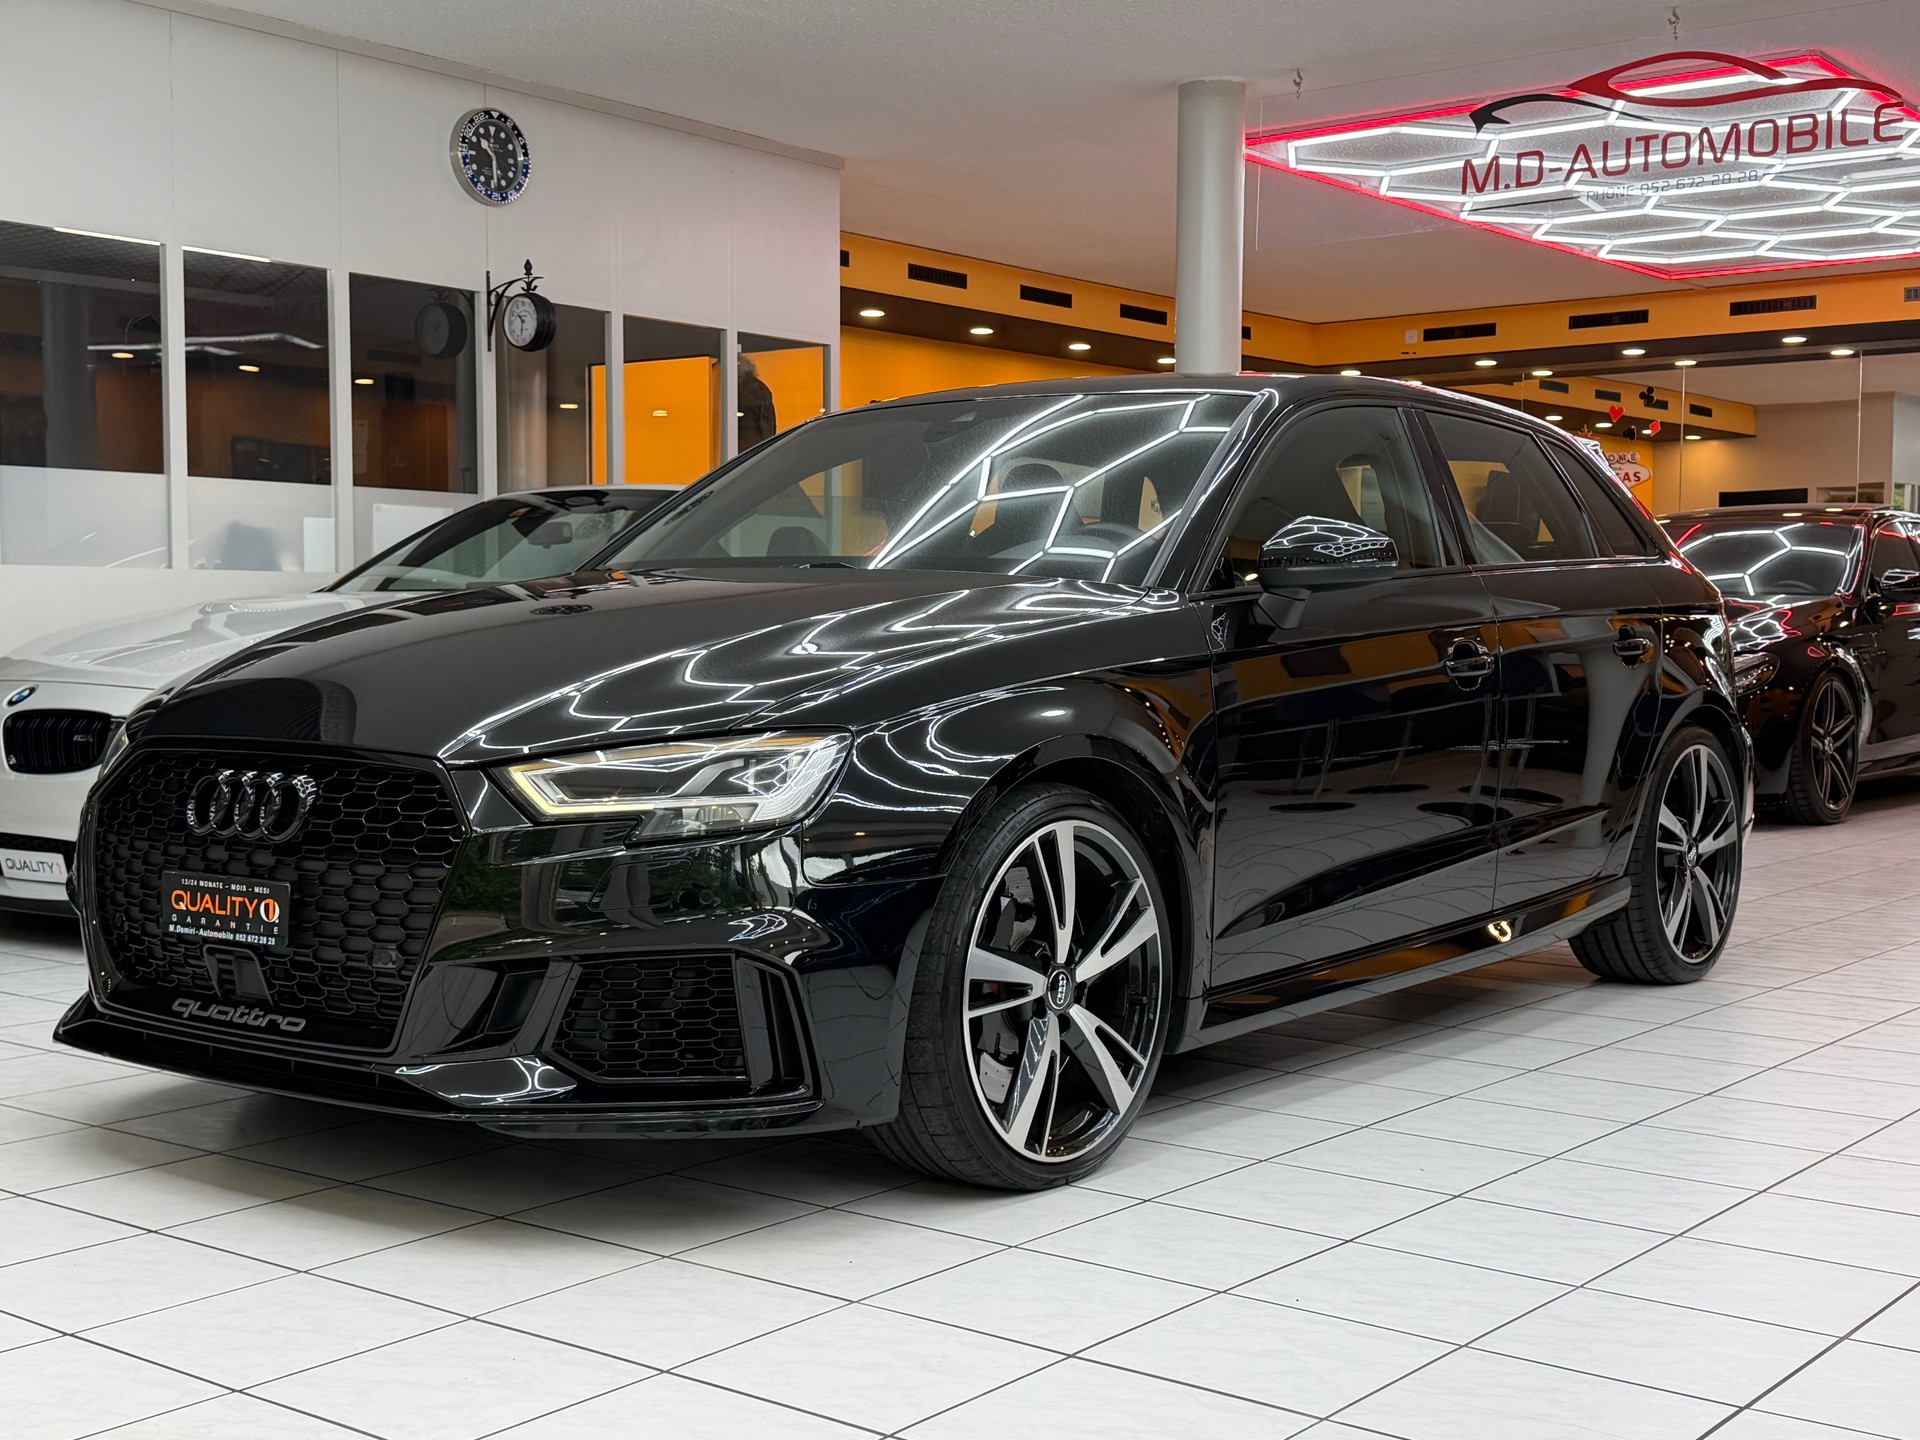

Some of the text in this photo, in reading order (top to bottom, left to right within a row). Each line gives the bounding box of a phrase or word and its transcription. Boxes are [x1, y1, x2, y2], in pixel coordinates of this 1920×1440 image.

[473, 112, 486, 123] 22
[1461, 101, 1905, 195] M.D-AUTOMOBILE
[1586, 184, 1635, 201] PHONE
[1675, 176, 1705, 189] 672
[1711, 173, 1732, 186] 28
[1737, 169, 1758, 182] 28
[199, 880, 224, 890] MONATE
[231, 883, 247, 892] MOIS
[254, 886, 270, 895] MESI
[171, 913, 279, 935] GARANTIE
[171, 998, 306, 1033] quattro
